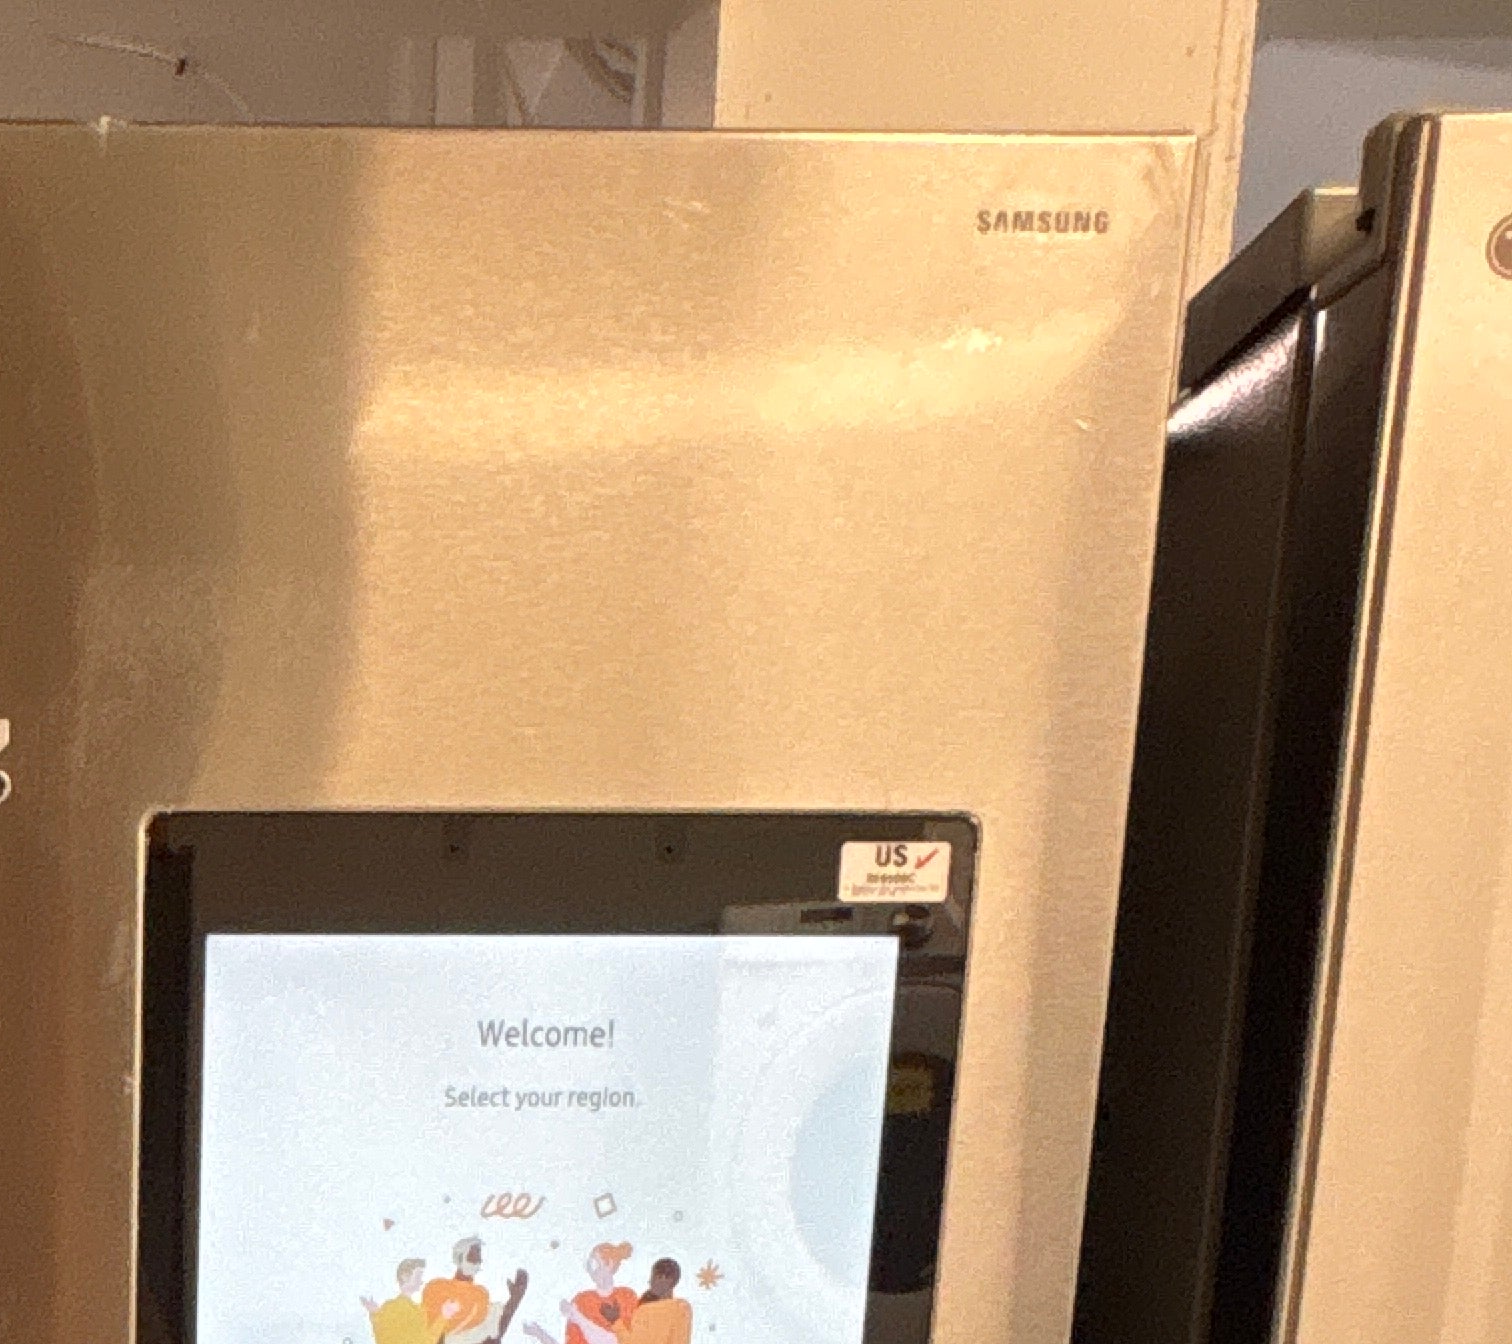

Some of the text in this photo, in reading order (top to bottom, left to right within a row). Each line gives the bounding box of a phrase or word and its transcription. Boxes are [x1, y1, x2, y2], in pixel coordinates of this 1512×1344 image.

[975, 209, 1110, 236] SAMSUNG
[874, 845, 909, 867] US
[477, 1018, 615, 1048] Welcome!
[444, 1085, 510, 1108] Select
[514, 1090, 564, 1112] your
